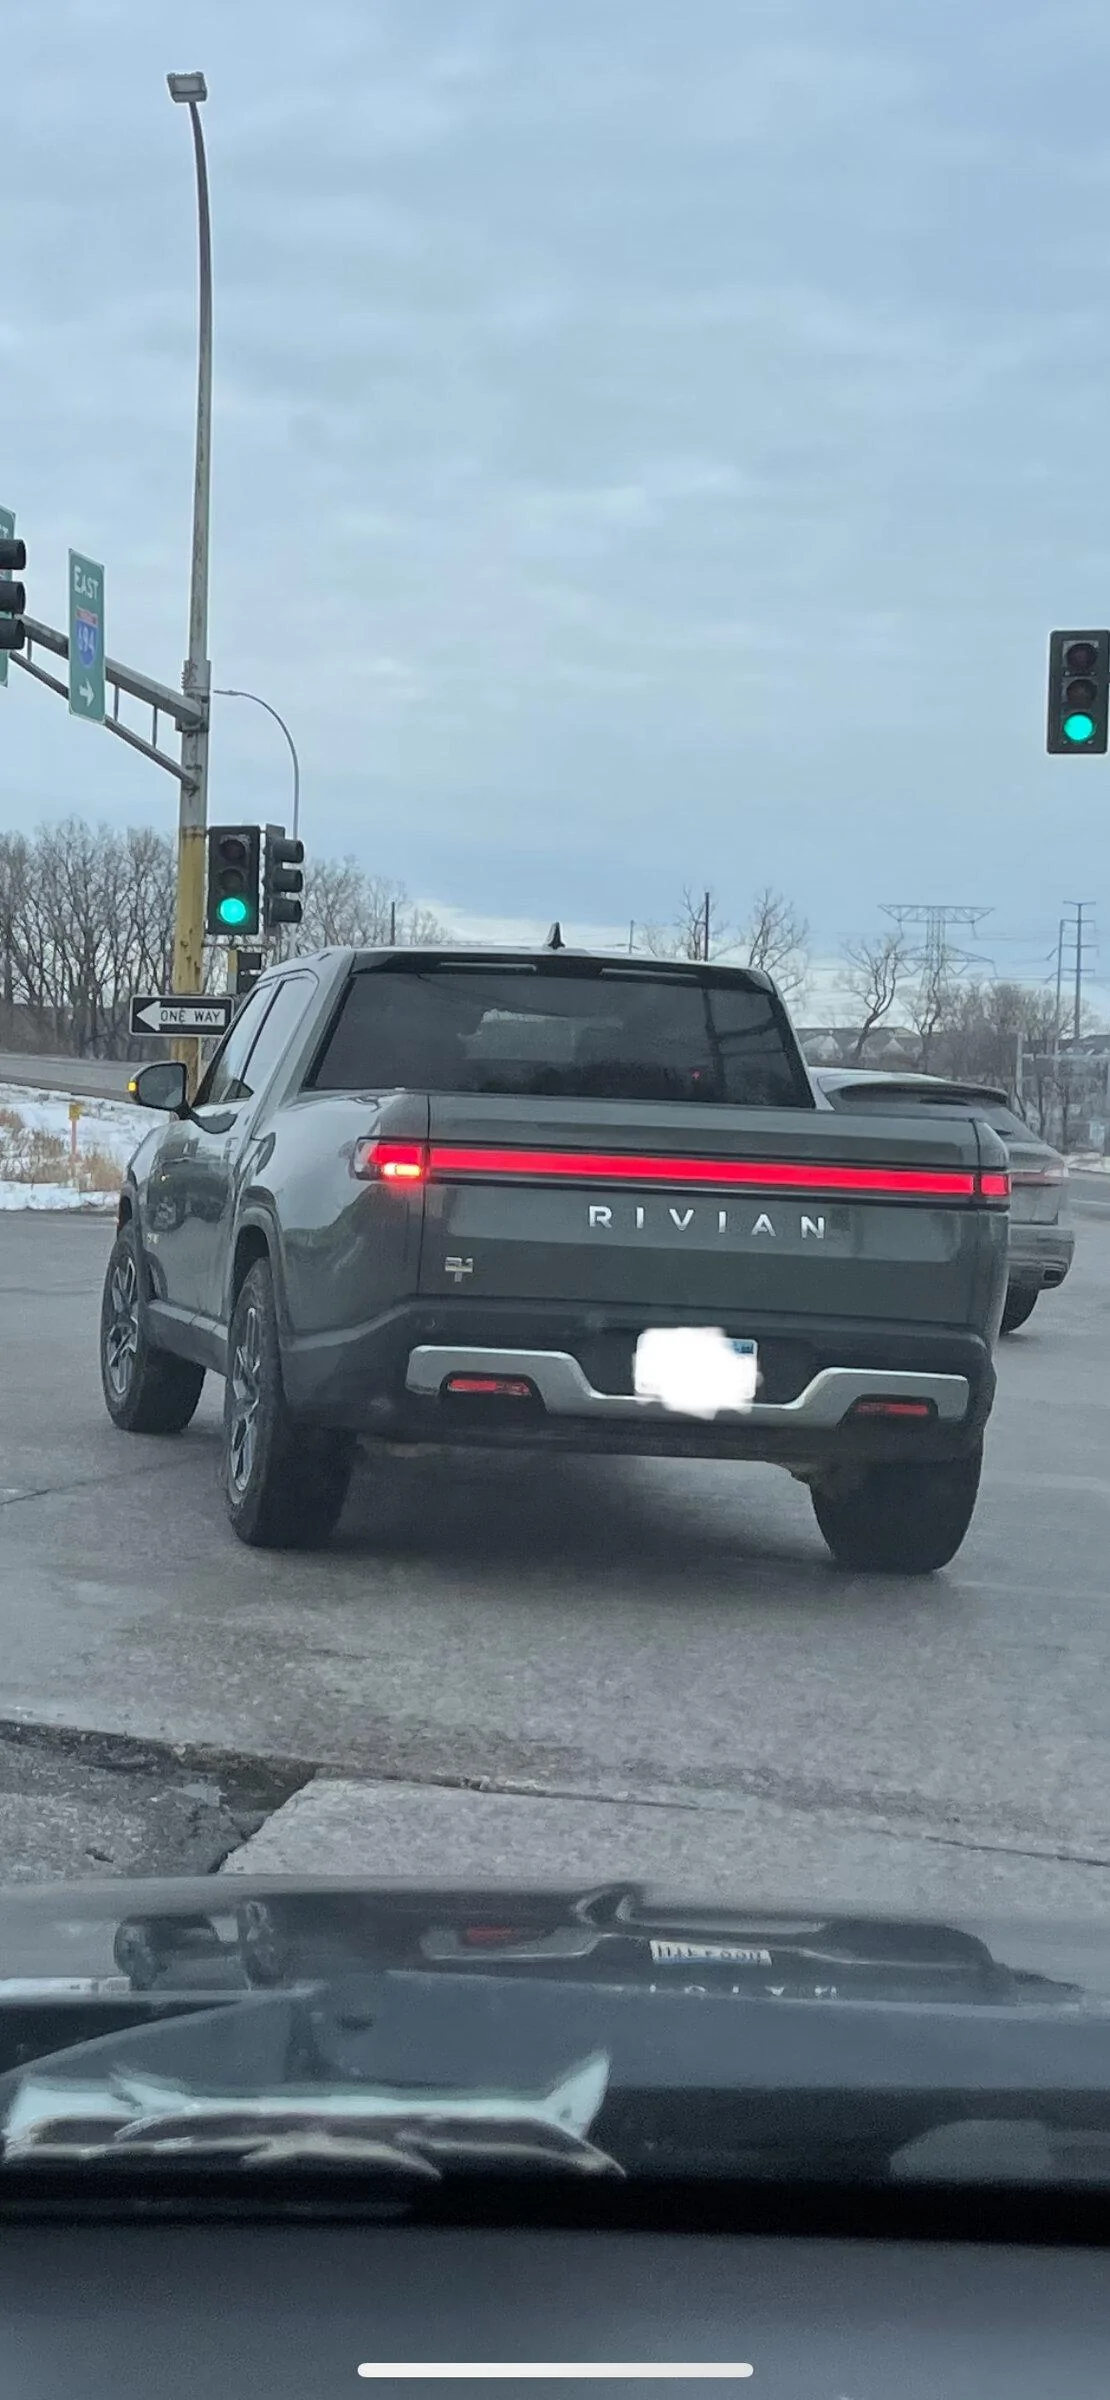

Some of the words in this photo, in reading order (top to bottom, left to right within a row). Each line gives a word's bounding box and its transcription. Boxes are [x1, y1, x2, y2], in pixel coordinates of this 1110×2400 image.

[74, 565, 99, 600] EAST
[160, 1010, 185, 1023] ONE
[194, 1010, 220, 1023] WAY
[588, 1205, 826, 1239] RIVIAN
